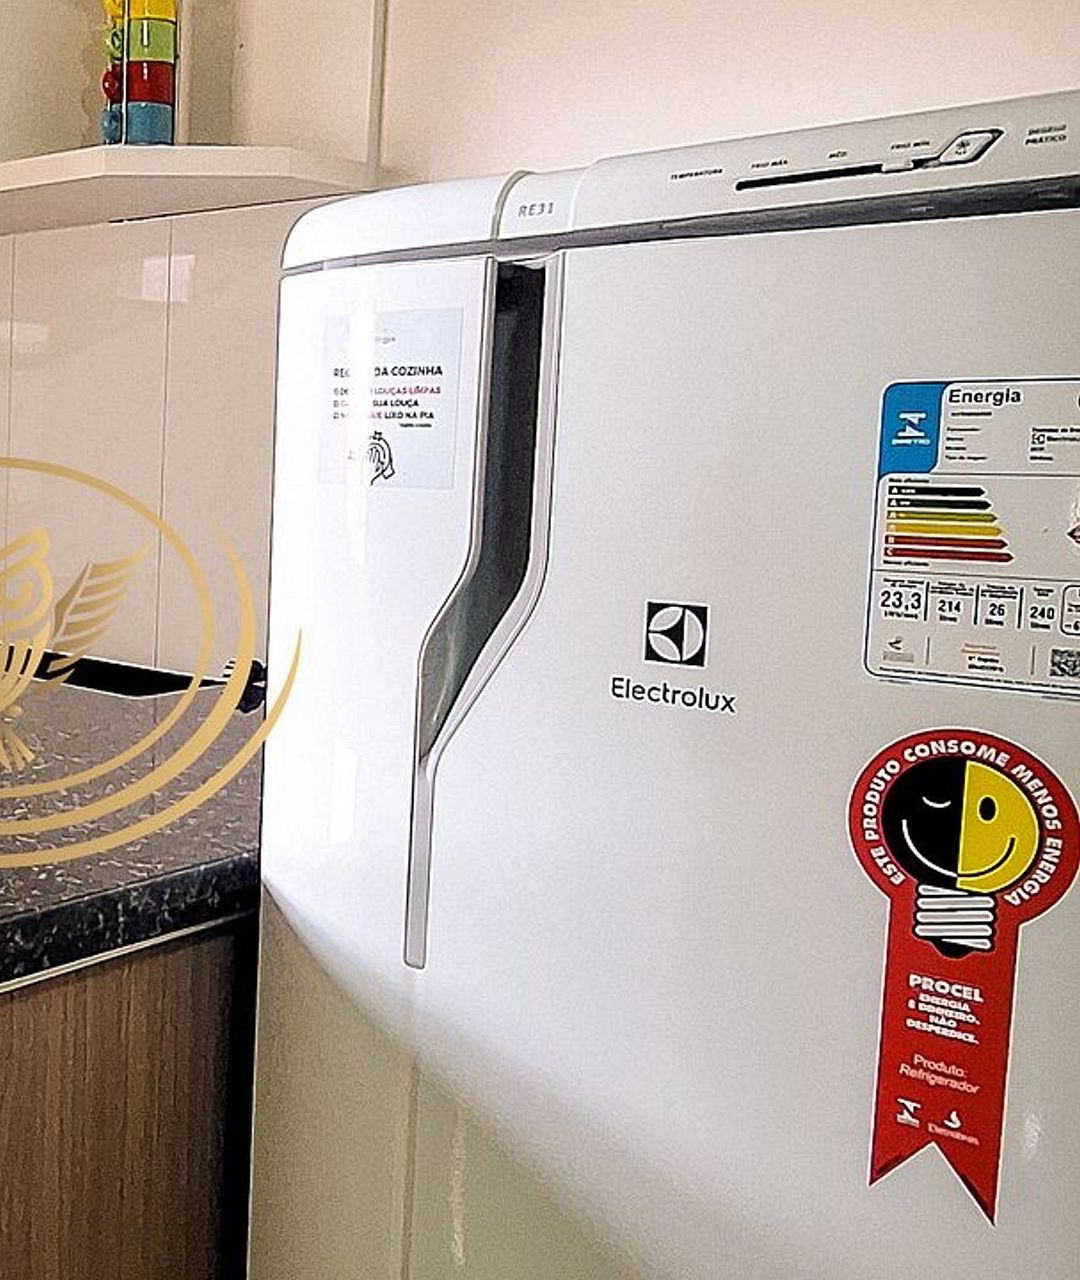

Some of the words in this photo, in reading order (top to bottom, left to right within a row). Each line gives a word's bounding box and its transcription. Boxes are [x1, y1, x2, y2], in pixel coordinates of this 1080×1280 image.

[518, 202, 554, 218] RE31
[390, 365, 443, 376] COZINHA
[374, 386, 408, 396] LOUÇAS
[948, 388, 1021, 406] Energia
[390, 399, 420, 408] LOUÇA
[880, 591, 921, 611] 23,3
[938, 600, 961, 613] 214
[989, 603, 1005, 617] 26
[1030, 606, 1055, 620] 240
[611, 677, 736, 713] Electrolux
[903, 740, 1010, 768] CONSOME
[863, 760, 901, 841] PRODUTO
[1010, 764, 1062, 830] MENOS
[871, 846, 906, 885] ESTE
[1004, 837, 1063, 906] ENERGIA
[909, 973, 984, 1002] PROCEL
[899, 1063, 980, 1094] Refrigerador
